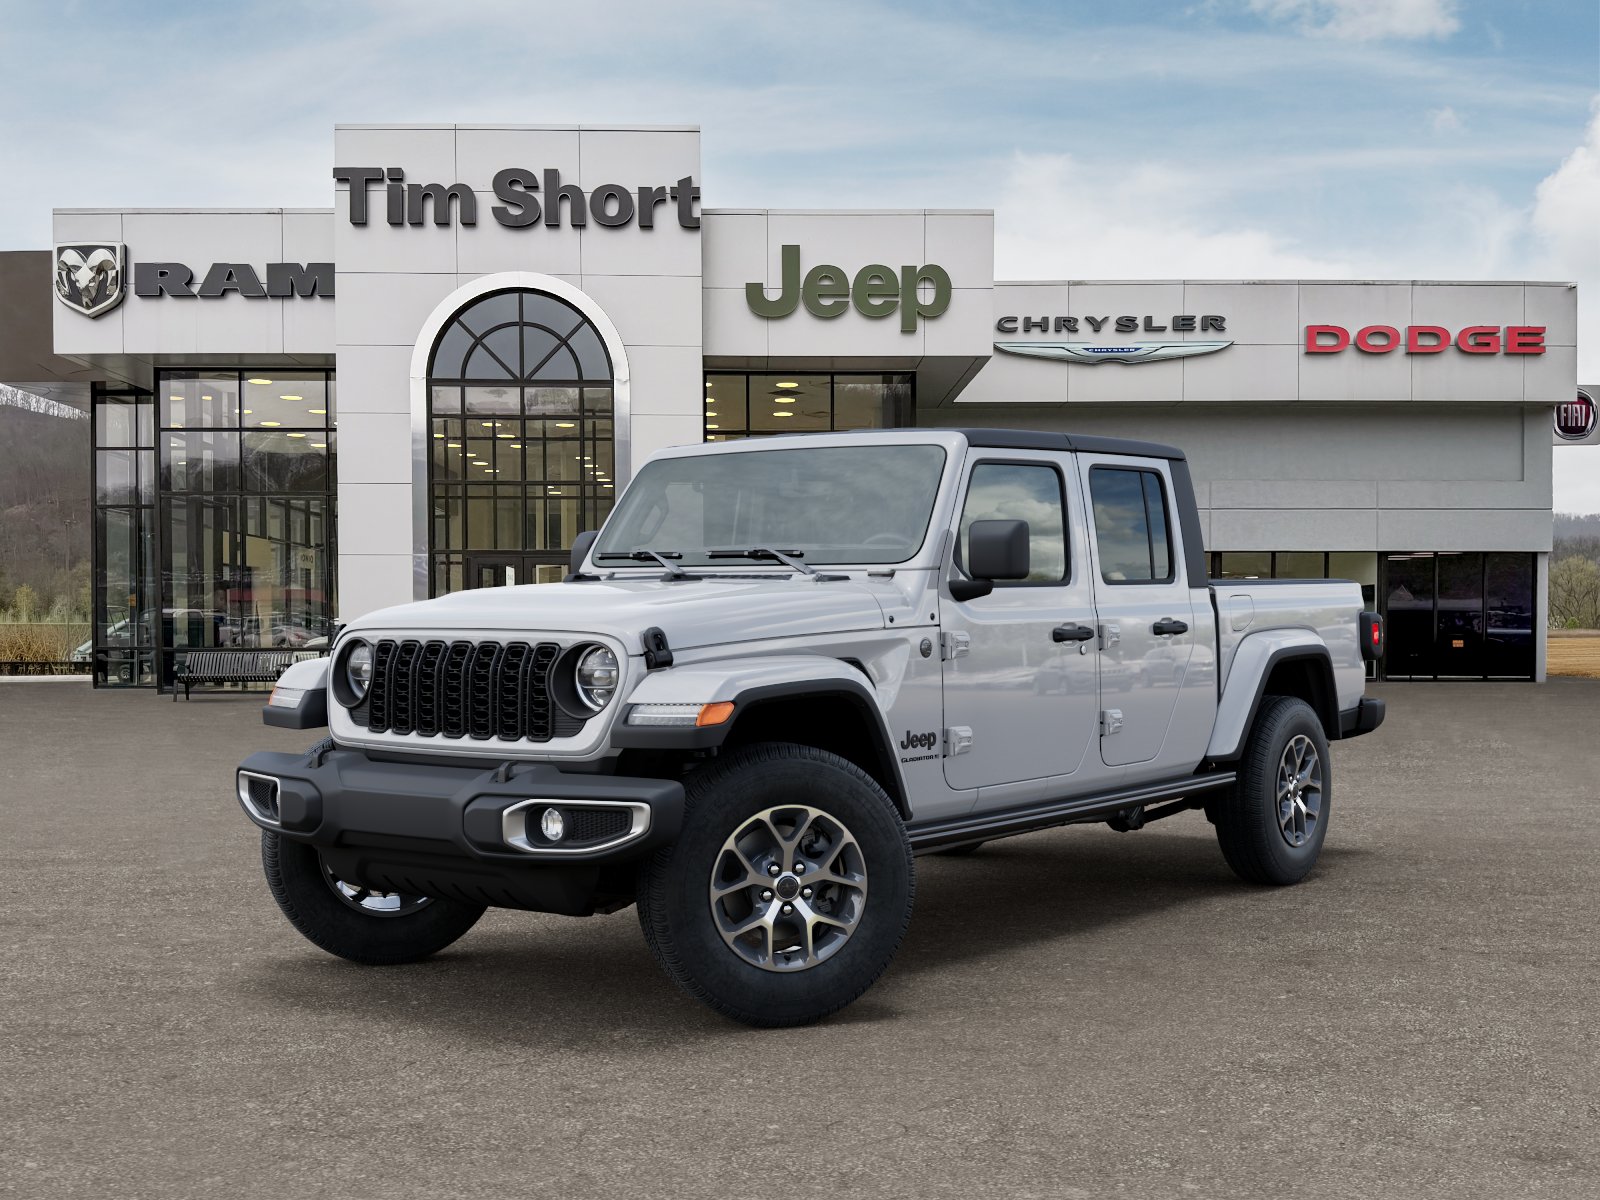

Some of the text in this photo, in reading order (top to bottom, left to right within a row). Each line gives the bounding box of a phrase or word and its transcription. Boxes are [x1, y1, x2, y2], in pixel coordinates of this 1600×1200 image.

[333, 167, 701, 229] Tim Short
[134, 262, 335, 298] RAM
[745, 244, 952, 333] Jeep
[996, 315, 1227, 333] CHRYSLER
[1305, 325, 1546, 355] DODGE
[1560, 404, 1586, 427] FIAT
[901, 730, 937, 750] Jeep
[901, 755, 934, 763] GLADIATOR
